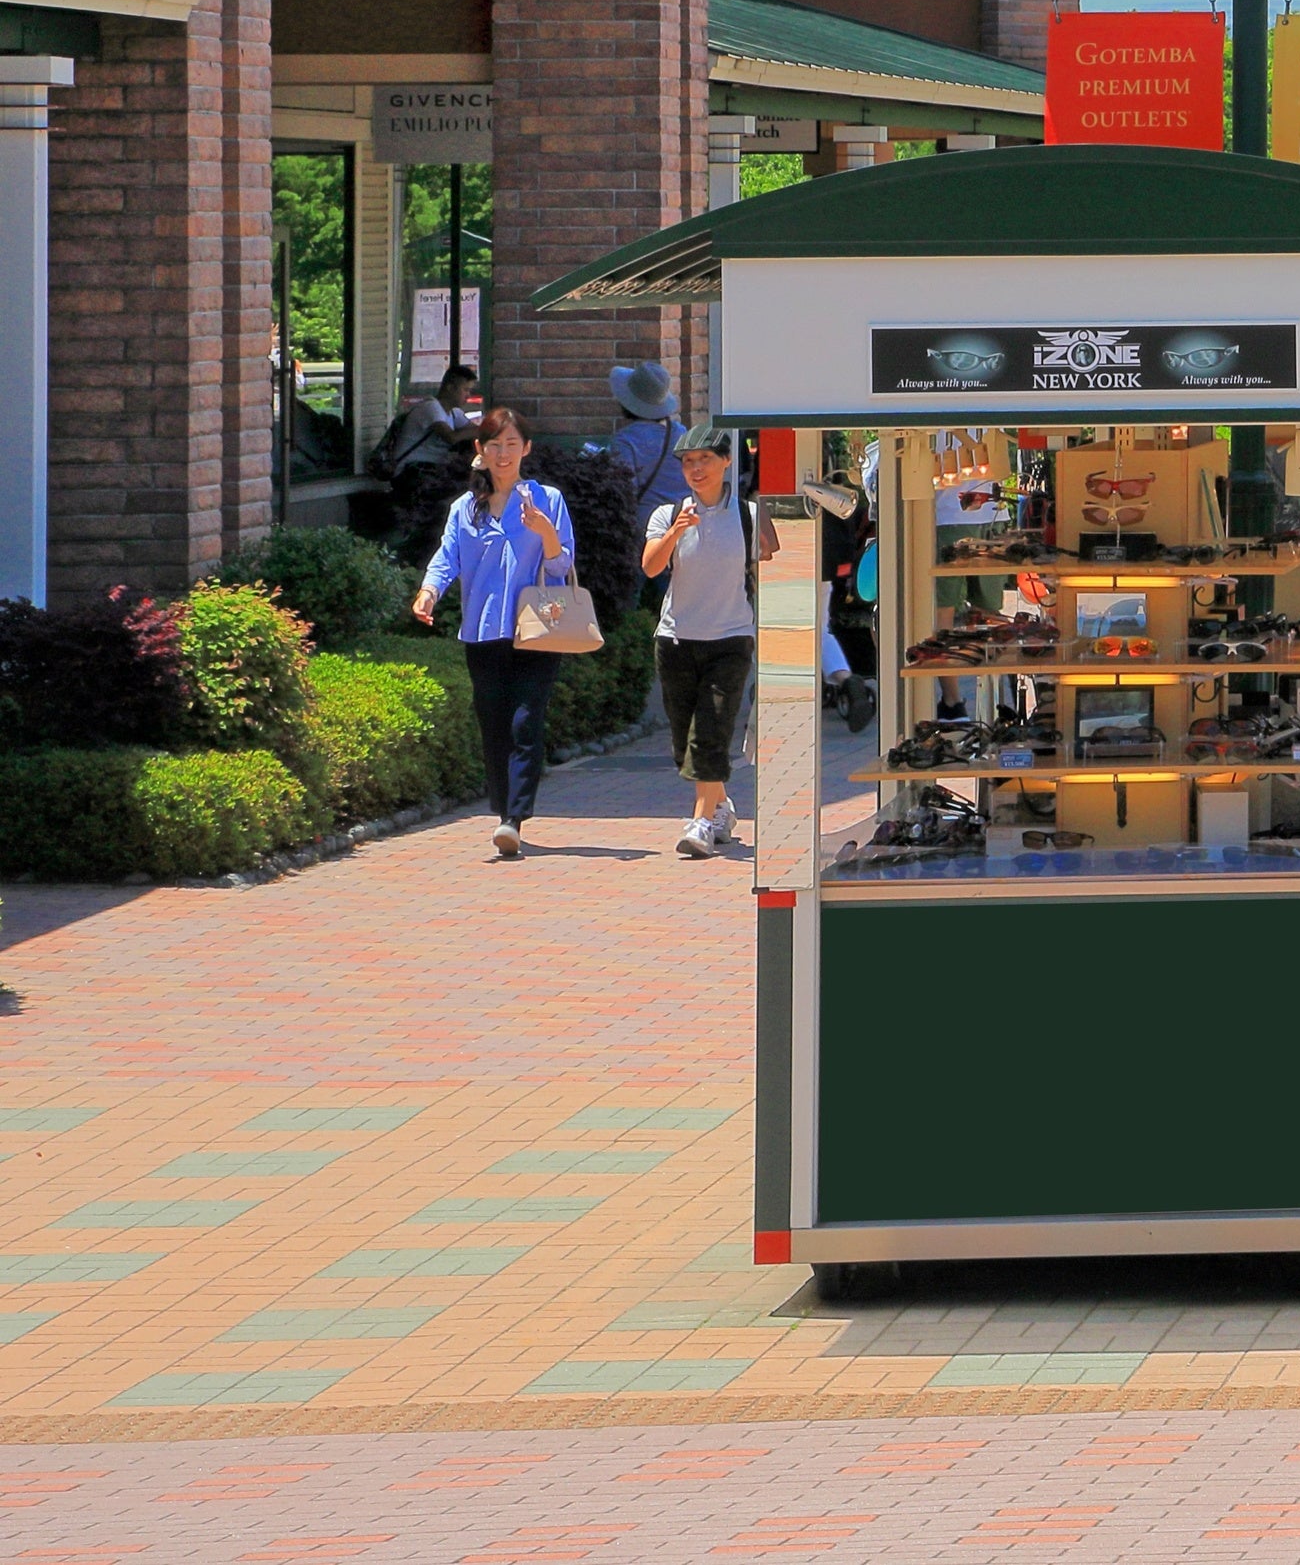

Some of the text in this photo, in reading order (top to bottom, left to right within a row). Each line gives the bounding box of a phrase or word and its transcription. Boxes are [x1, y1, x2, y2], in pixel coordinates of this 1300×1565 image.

[1074, 42, 1197, 66] GOTEMBA
[1078, 78, 1191, 96] PREMIUM
[390, 94, 494, 108] GIVENCH
[391, 117, 458, 132] EMILIO
[1080, 110, 1189, 128] OUTLETS
[896, 378, 988, 390] Always with you...
[1032, 372, 1142, 389] NEW YORK
[1181, 374, 1272, 387] Always with you...
